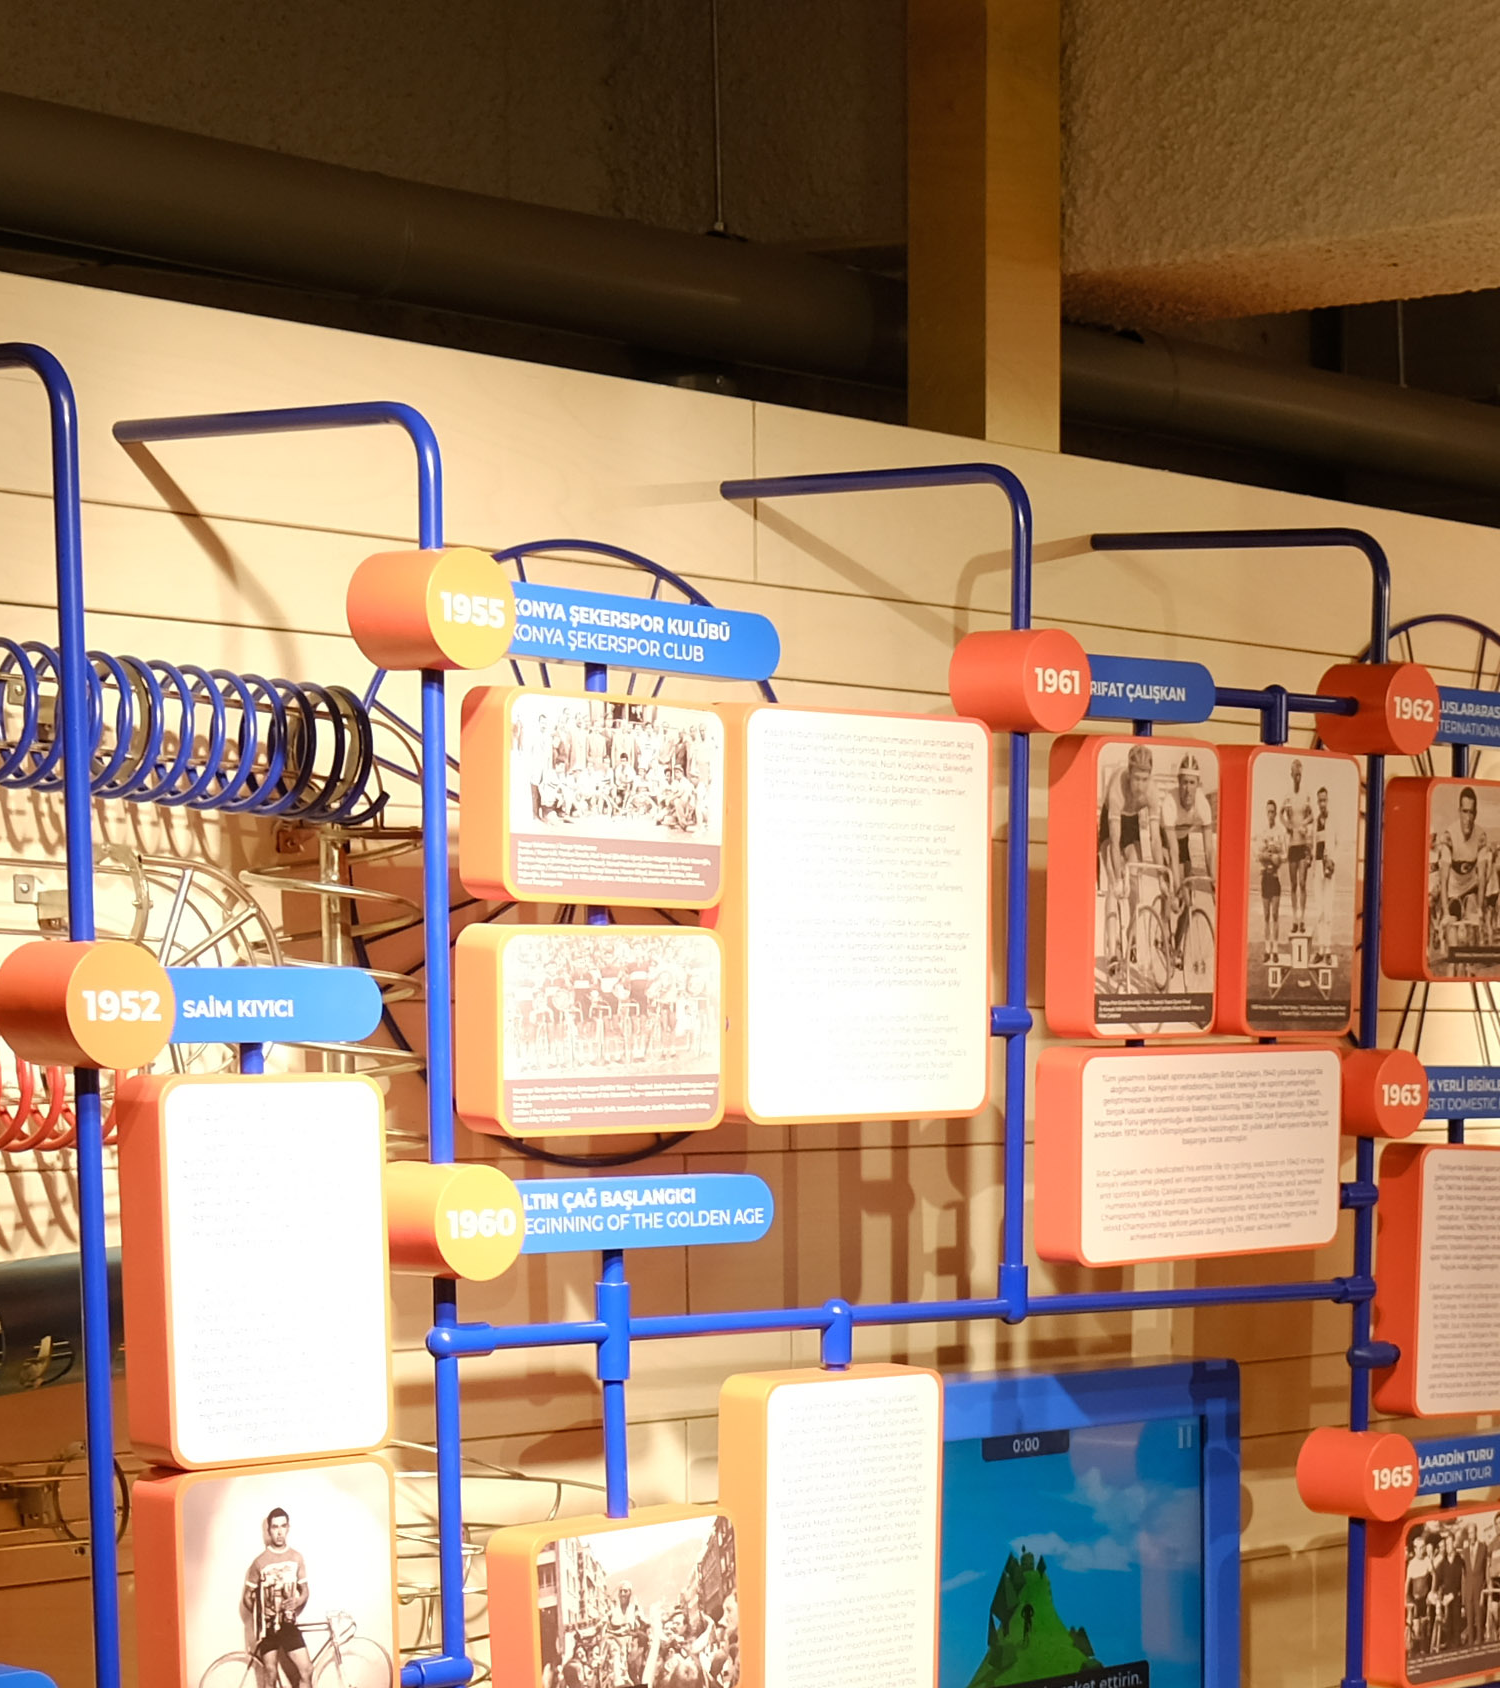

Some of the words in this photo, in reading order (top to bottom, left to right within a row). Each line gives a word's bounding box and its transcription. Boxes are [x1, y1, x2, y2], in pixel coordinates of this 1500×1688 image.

[440, 591, 505, 628] 1955
[568, 605, 664, 632] ŞEKERSPOR
[666, 617, 730, 641] KULÜBÜ
[566, 629, 660, 656] ŞEKERSPOR
[662, 641, 704, 662] CLUB
[1034, 667, 1080, 695] 1961
[1126, 684, 1186, 704] ÇALIŞKAN
[1393, 696, 1434, 723] 1962
[82, 990, 162, 1023] 1952
[181, 995, 233, 1018] SAİM
[236, 998, 294, 1017] KIYICI
[1382, 1083, 1422, 1107] 1963
[1437, 1076, 1465, 1092] YERLİ
[1428, 1097, 1446, 1110] RST
[1448, 1097, 1497, 1110] DOMESTIC
[522, 1192, 559, 1213] LTIN
[560, 1187, 597, 1211] ÇAĞ
[599, 1187, 696, 1209] BAŞLANGICI
[446, 1208, 517, 1240] 1960
[523, 1214, 604, 1235] EGINNING
[606, 1213, 630, 1230] OF
[630, 1211, 664, 1229] THE
[665, 1209, 730, 1227] GOLDEN
[732, 1207, 764, 1224] AGE
[1012, 1437, 1040, 1453] 0:00
[1418, 1448, 1465, 1470] LAADDİN
[1467, 1448, 1495, 1462] TURU
[1372, 1464, 1413, 1491] 1965
[1418, 1471, 1462, 1488] LAADDIN
[1464, 1465, 1493, 1479] TOUR
